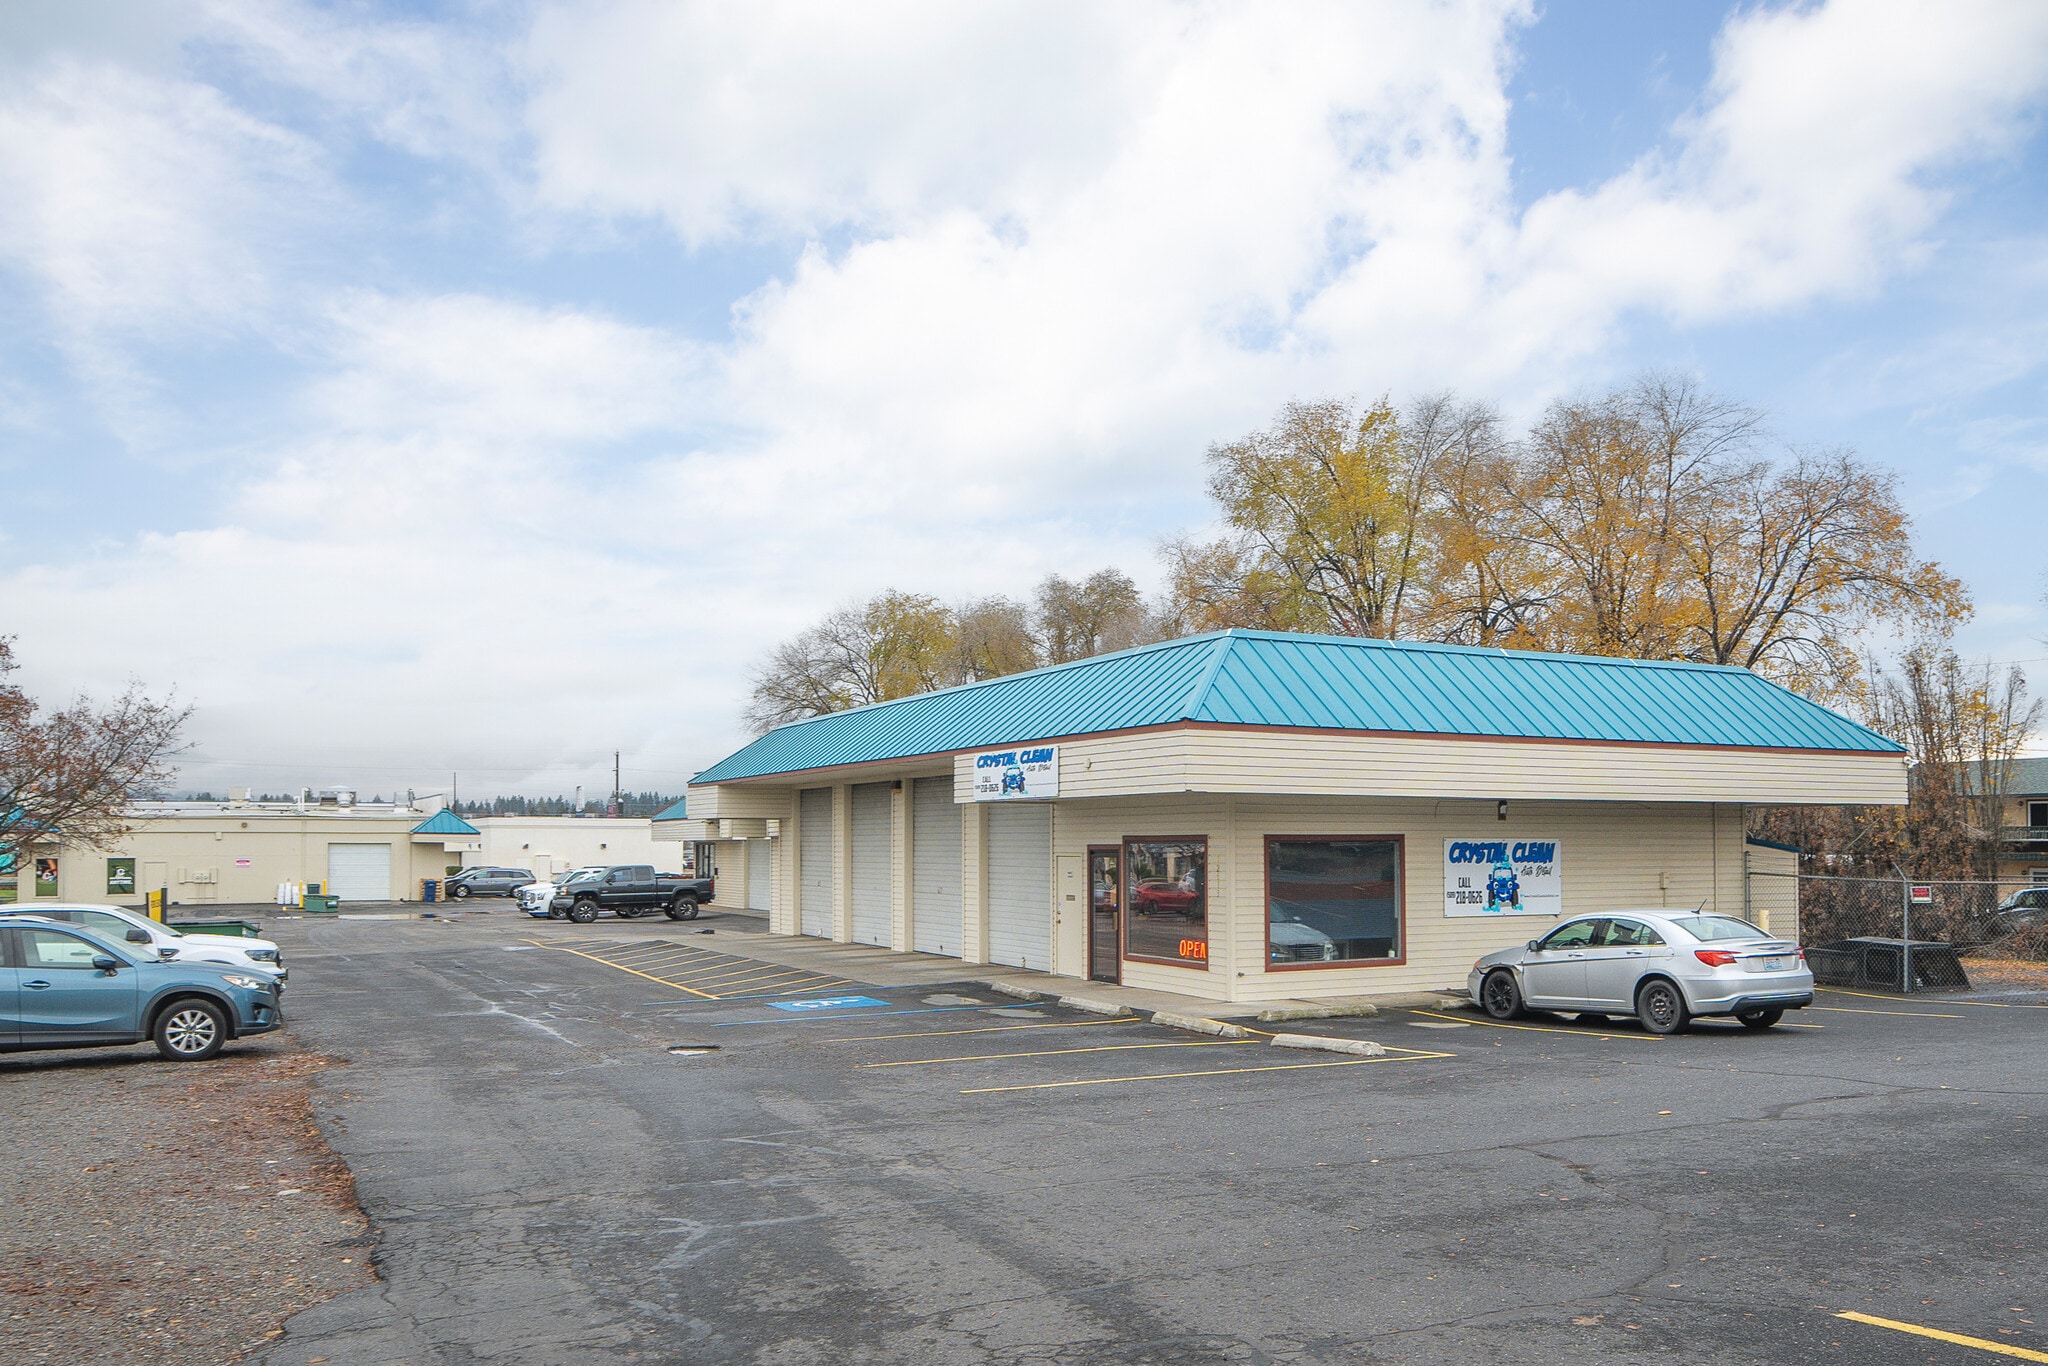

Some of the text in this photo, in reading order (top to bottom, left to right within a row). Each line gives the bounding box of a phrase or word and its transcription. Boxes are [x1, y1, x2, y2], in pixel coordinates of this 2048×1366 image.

[1020, 748, 1054, 764] CLEAN
[1449, 842, 1556, 864] CRYSTAL CLEAN
[1521, 865, 1533, 877] Auto
[1458, 877, 1472, 888] CALL
[1456, 891, 1483, 904] 218-0626
